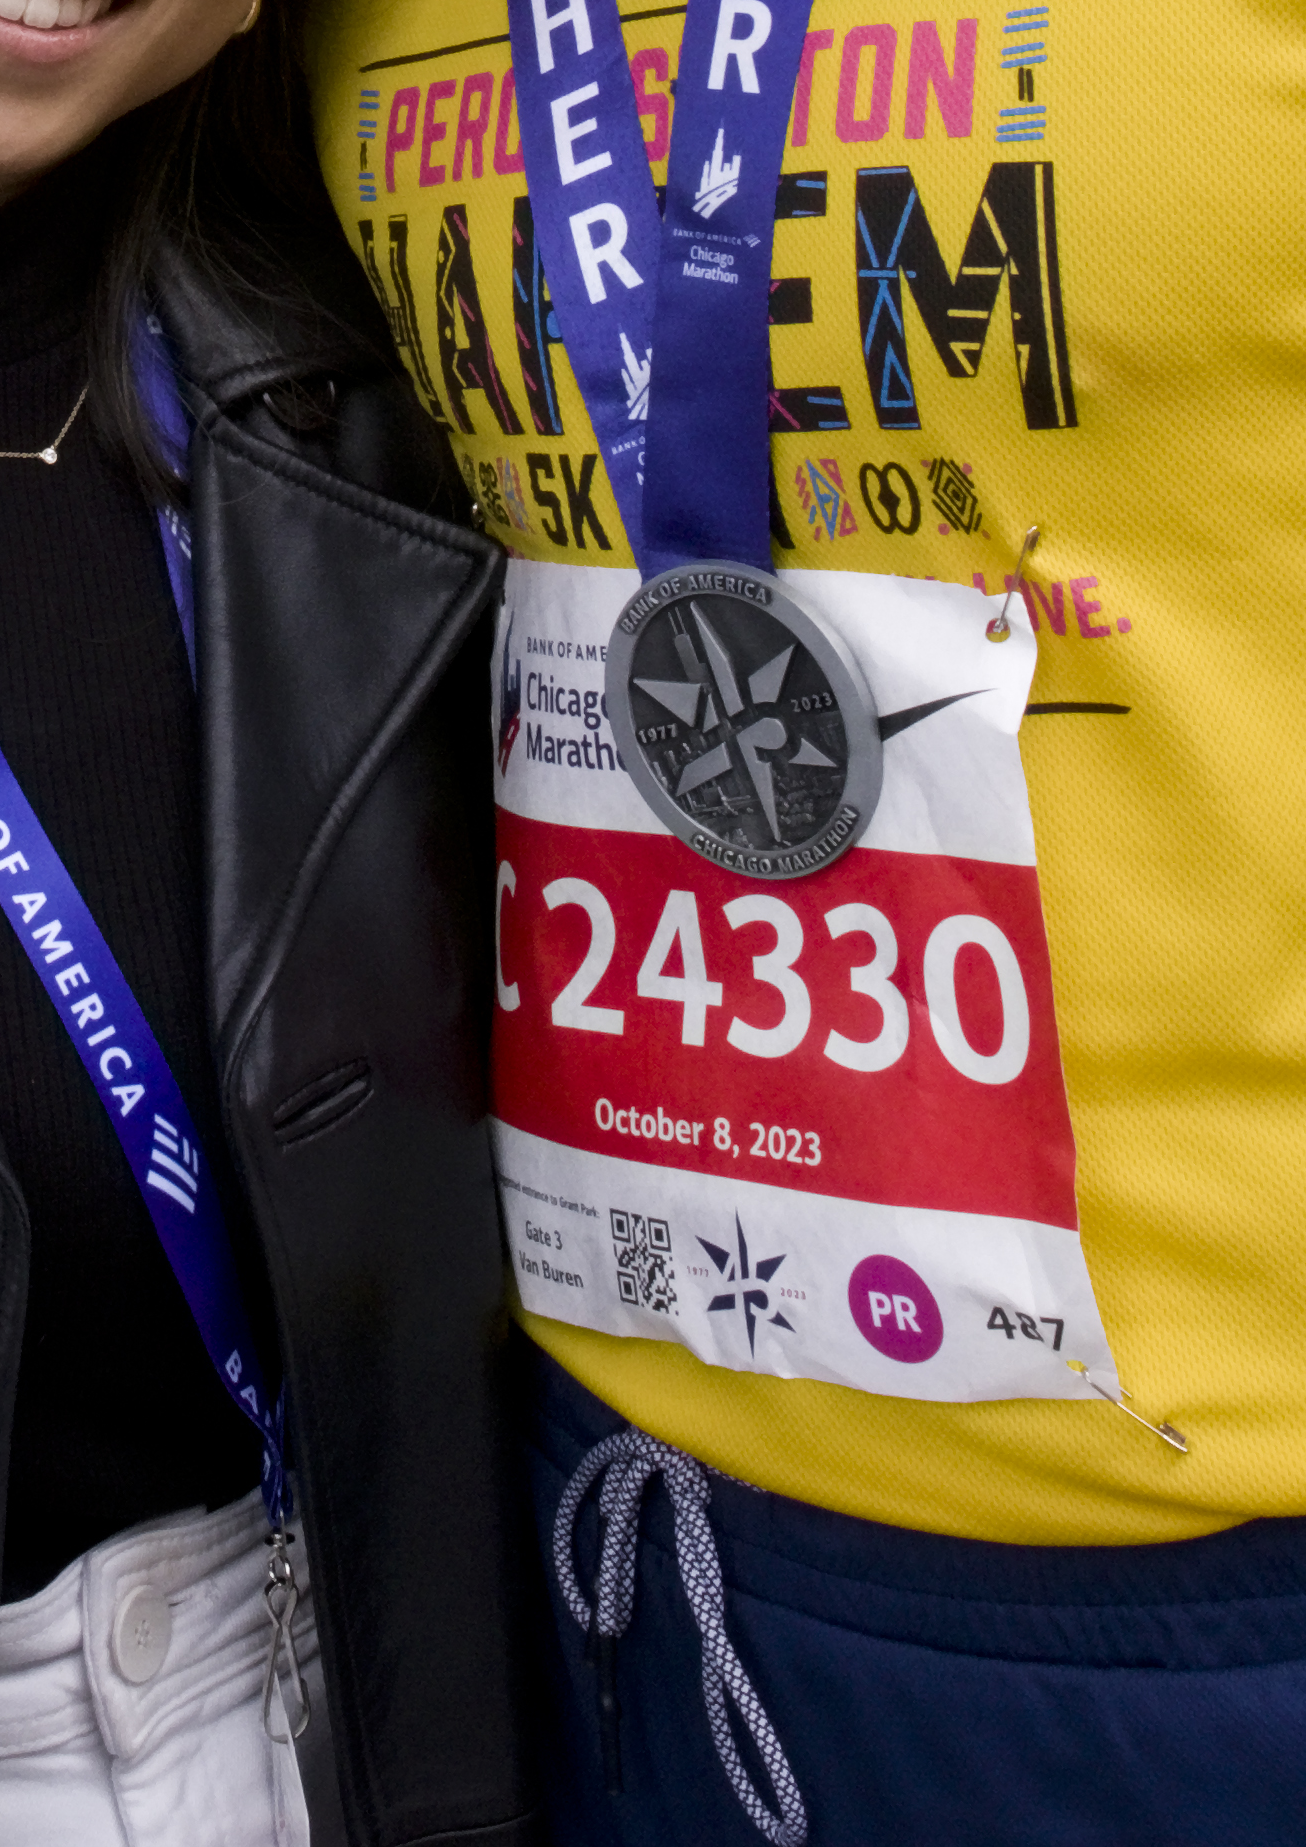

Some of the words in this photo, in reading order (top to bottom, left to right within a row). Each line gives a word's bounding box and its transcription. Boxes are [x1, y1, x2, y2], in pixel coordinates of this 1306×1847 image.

[385, 66, 525, 193] PERC
[683, 261, 739, 284] Marathon
[690, 245, 734, 268] Chicago
[526, 453, 613, 550] 5K
[620, 591, 660, 633] BANK
[660, 577, 681, 598] OF
[688, 574, 767, 604] AMERICA
[527, 637, 553, 657] BANK
[557, 641, 572, 659] OF
[575, 644, 607, 662] AME
[790, 692, 833, 713] 2023
[526, 721, 628, 773] Marath
[638, 723, 678, 745] 1977
[694, 834, 772, 874] CHICAGO
[777, 807, 858, 874] MARATHON
[542, 877, 1031, 1085] 24330
[12, 891, 146, 1117] AMERICA
[595, 1097, 704, 1146] October
[714, 1117, 740, 1157] 8,
[749, 1122, 822, 1166] 2023
[559, 1196, 579, 1213] Grant
[525, 1220, 552, 1248] Gate
[554, 1229, 564, 1251] 3
[519, 1250, 539, 1276] Van
[542, 1259, 584, 1289] Buren
[686, 1265, 710, 1278] 1977
[779, 1286, 807, 1301] 2023
[868, 1290, 922, 1334] PR
[986, 1305, 1065, 1352] 487
